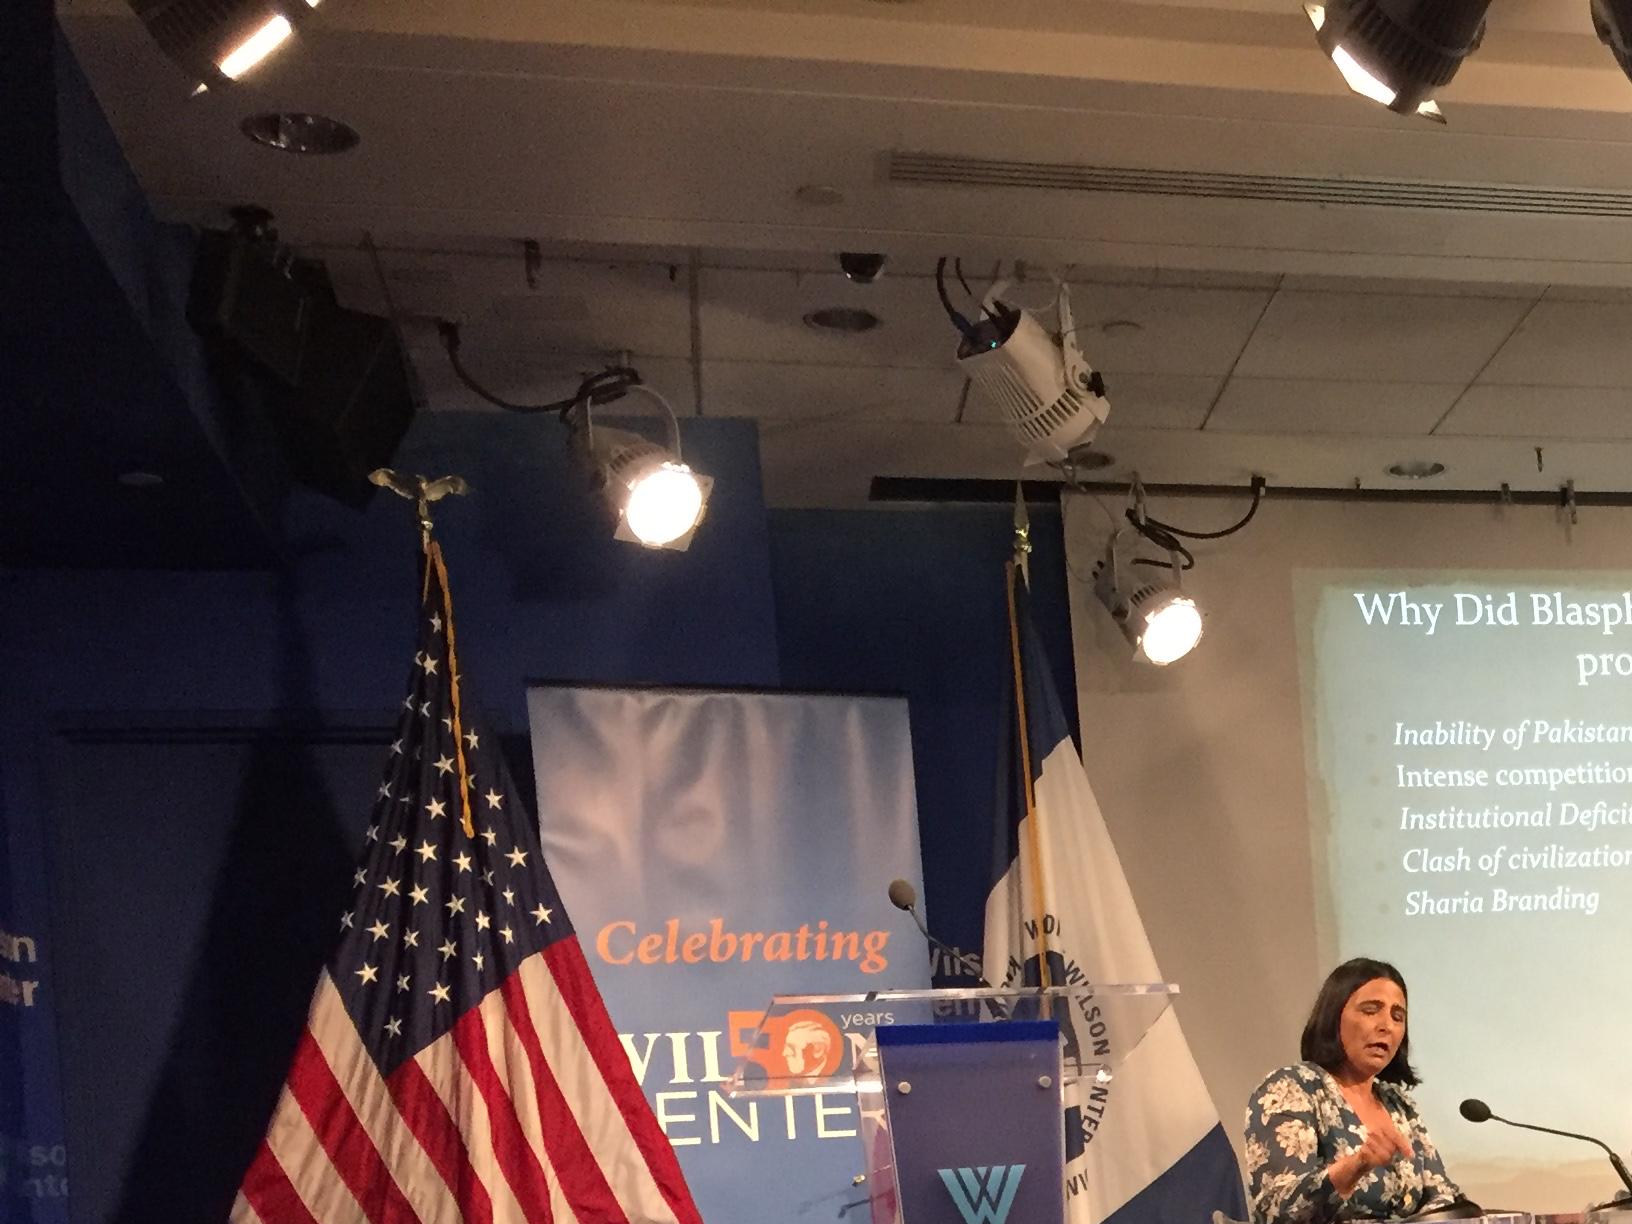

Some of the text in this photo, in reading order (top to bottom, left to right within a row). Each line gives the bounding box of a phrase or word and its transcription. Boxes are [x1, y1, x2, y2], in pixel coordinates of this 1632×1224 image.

[1354, 592, 1443, 634] Why
[1454, 592, 1519, 627] Did
[1394, 721, 1496, 751] Inability
[1502, 719, 1531, 748] of
[1396, 764, 1489, 788] Intense
[1399, 803, 1553, 831] Institutional
[1402, 848, 1472, 874] Clash
[1477, 846, 1507, 875] of
[1404, 887, 1600, 917] Sharia Branding
[597, 915, 890, 974] Celebrating
[840, 1010, 895, 1029] years
[655, 1090, 886, 1146] ENTE
